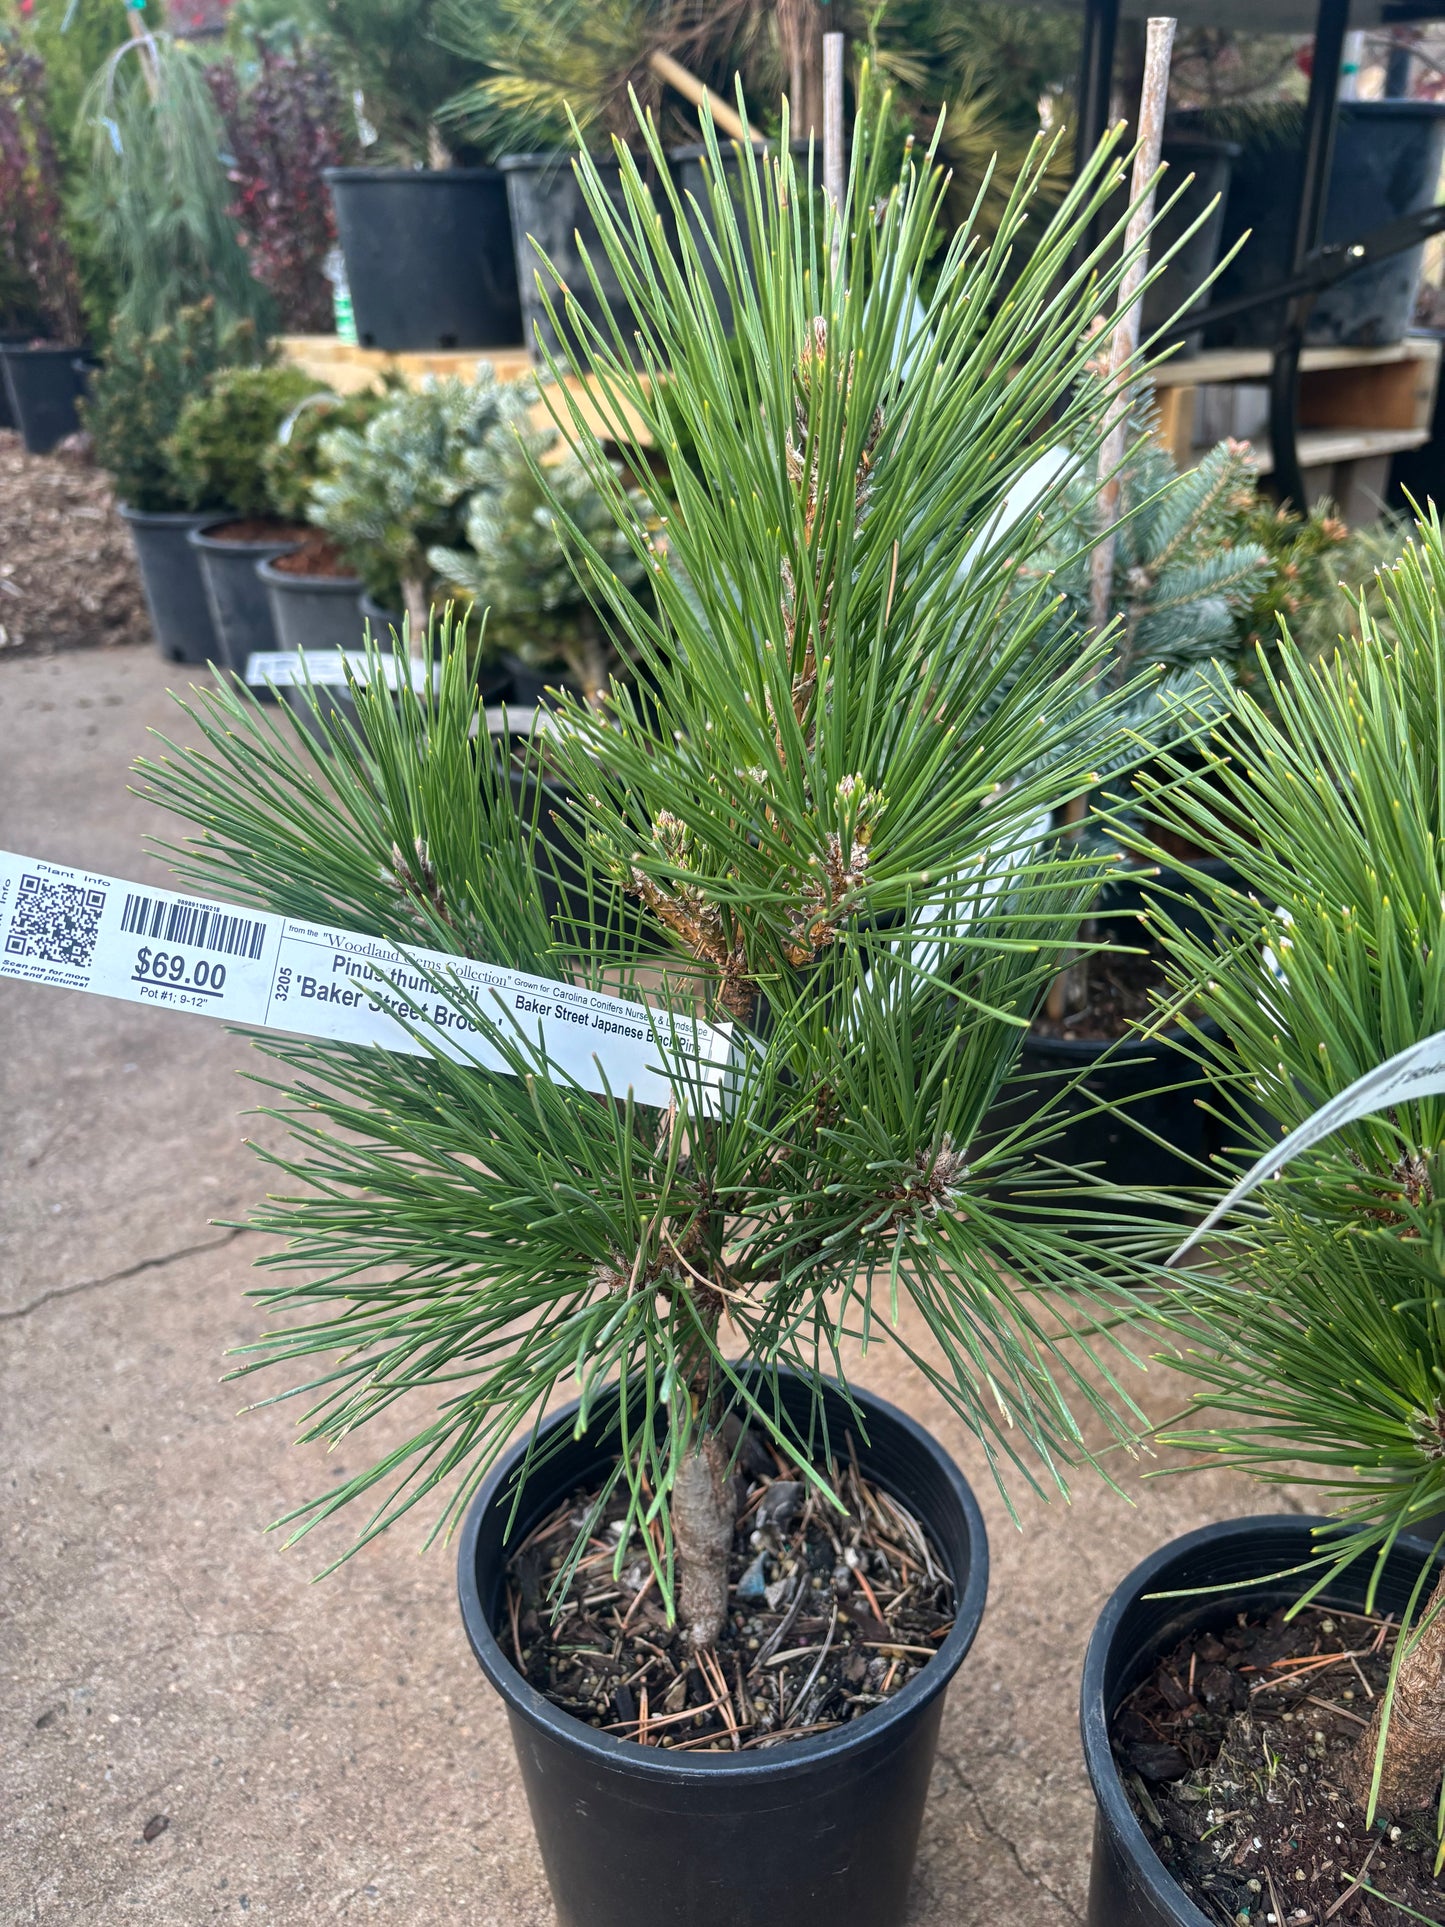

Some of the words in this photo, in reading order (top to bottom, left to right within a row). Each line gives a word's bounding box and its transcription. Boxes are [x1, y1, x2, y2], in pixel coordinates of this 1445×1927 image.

[36, 864, 75, 878] Plant
[84, 876, 111, 887] Info
[2, 960, 28, 970] Scan
[65, 973, 90, 982] more
[43, 976, 89, 988] pictures!
[134, 946, 226, 990] $69.00
[289, 925, 305, 935] from
[307, 929, 318, 938] the
[514, 978, 538, 989] Grown
[540, 984, 550, 993] for
[552, 987, 588, 1005] Carolina
[590, 997, 623, 1015] Conifers
[625, 1007, 656, 1023] Nursey
[658, 1015, 664, 1025] &
[140, 986, 159, 999] Pot
[161, 991, 177, 1004] #1;
[275, 967, 292, 1001] 3205
[515, 994, 552, 1016] Baker
[554, 1004, 589, 1026] Street
[591, 1015, 644, 1040] Japanese
